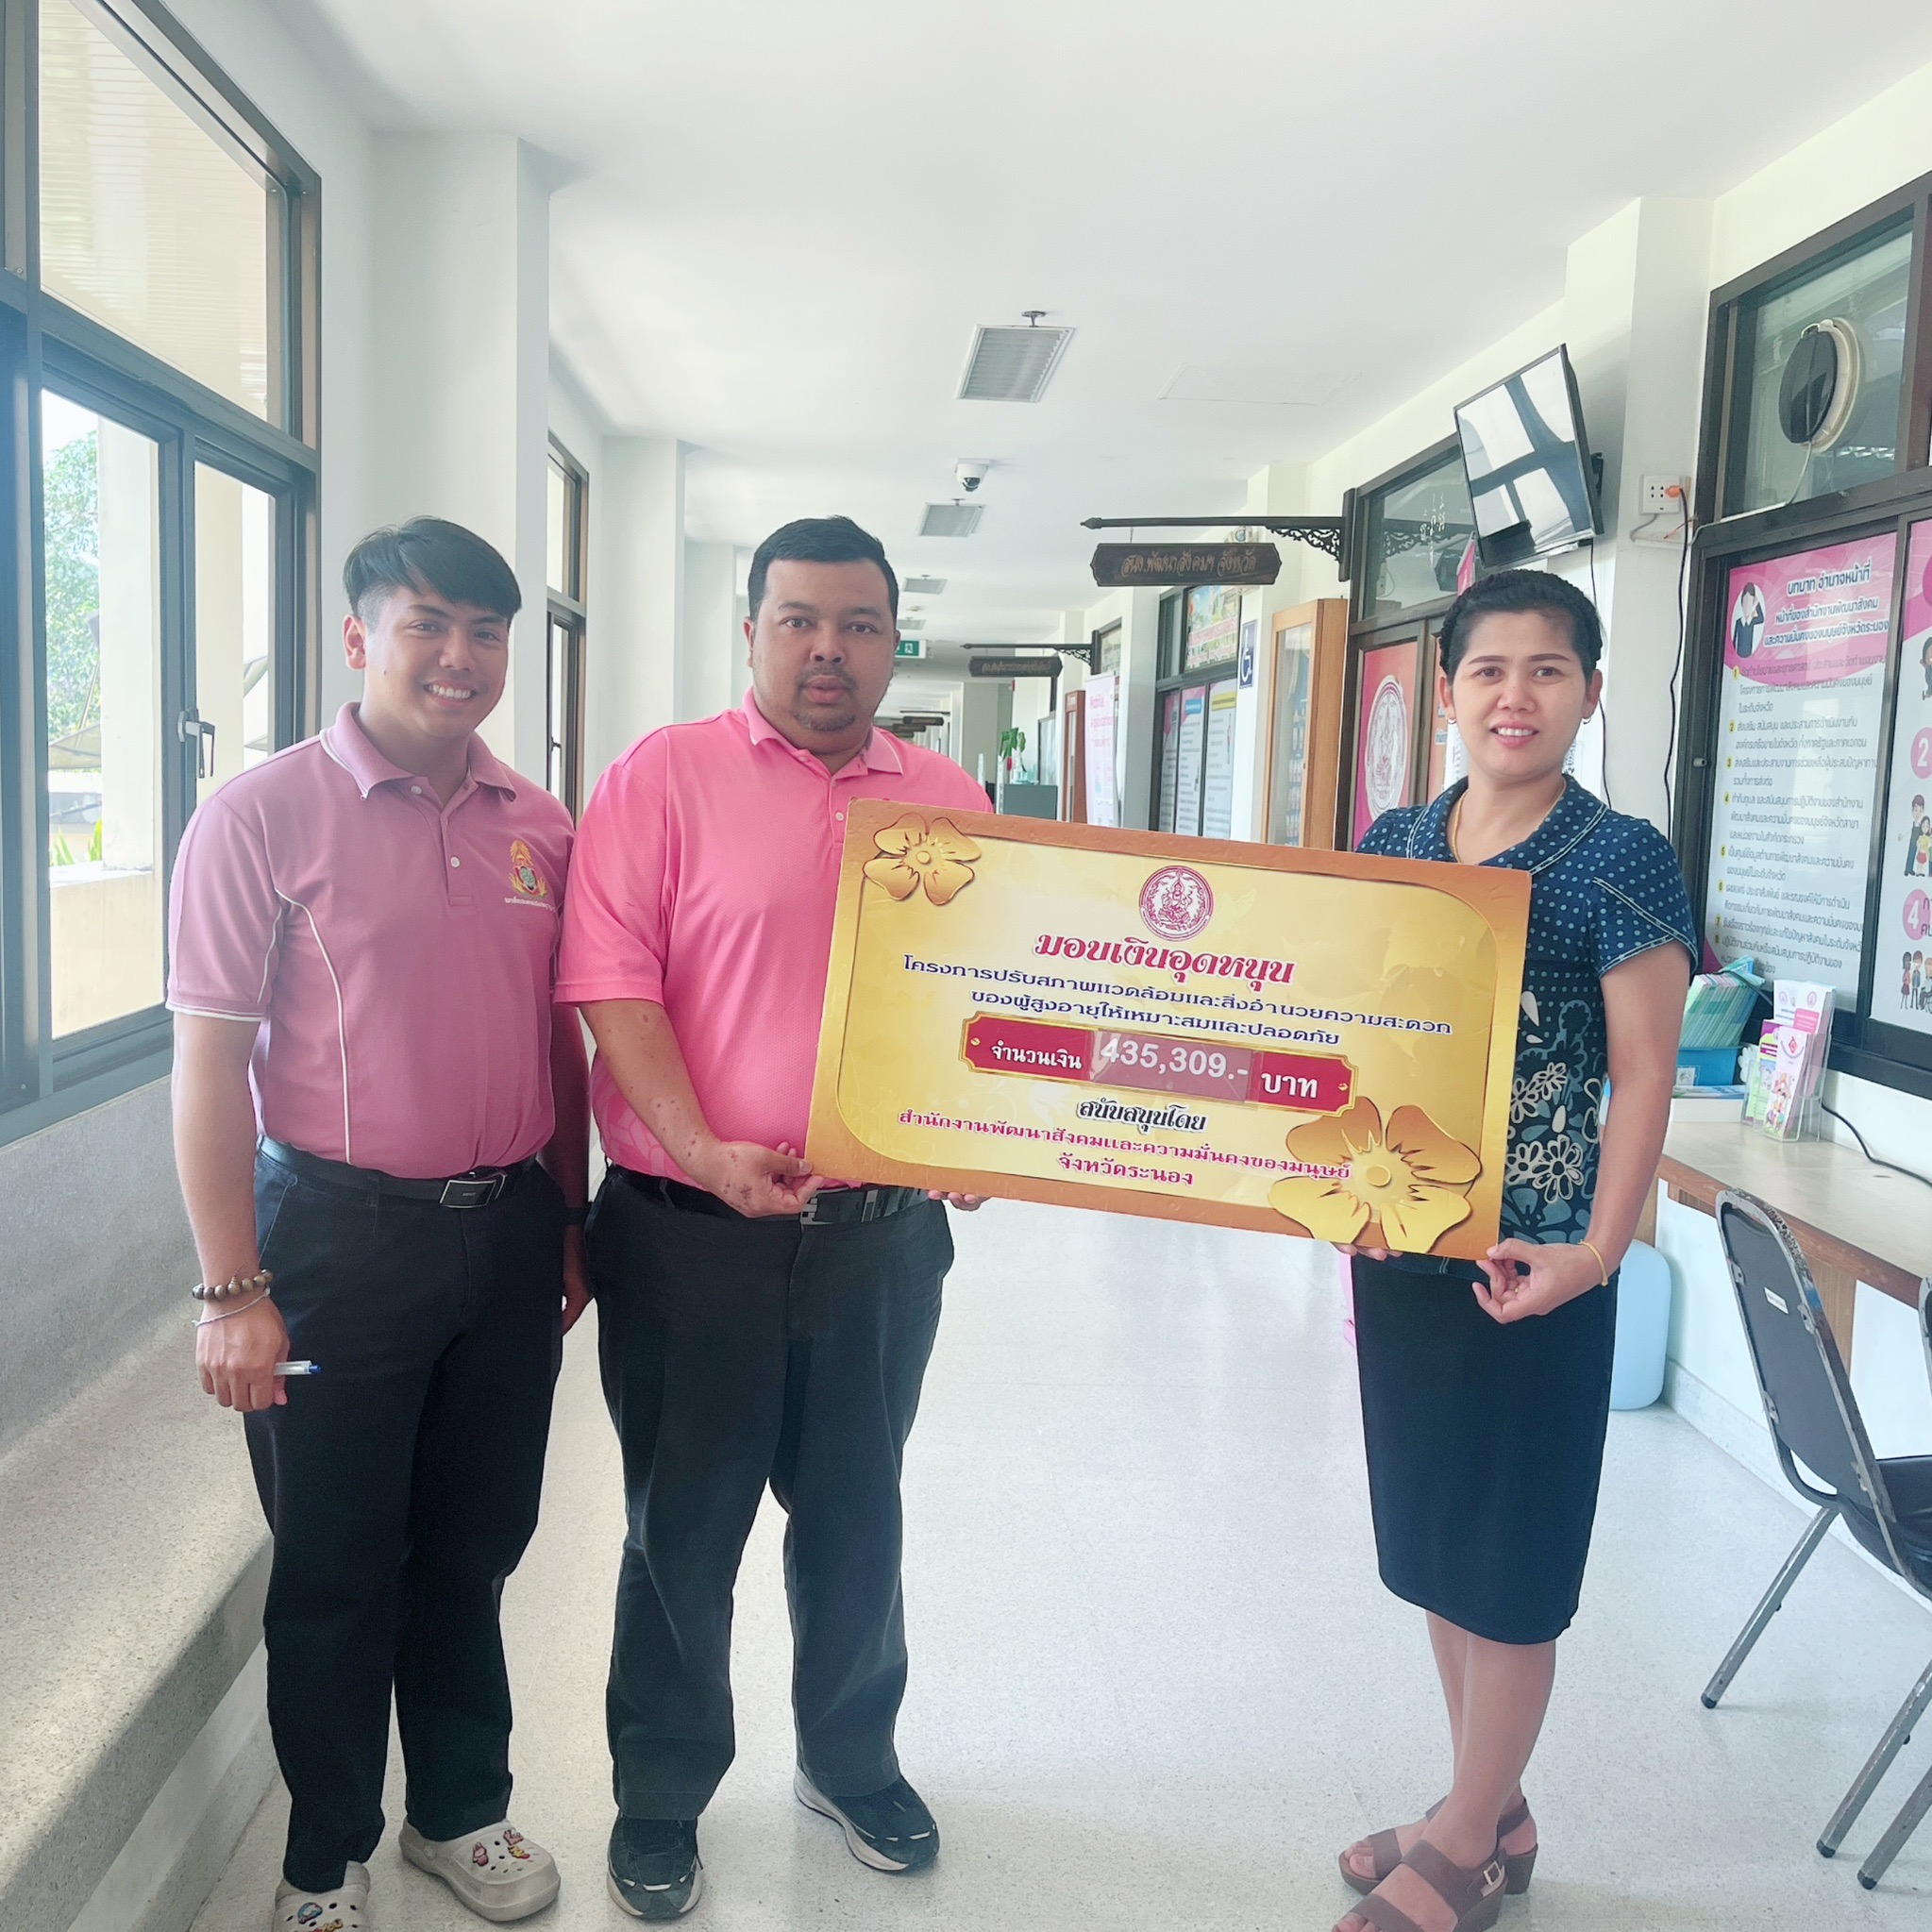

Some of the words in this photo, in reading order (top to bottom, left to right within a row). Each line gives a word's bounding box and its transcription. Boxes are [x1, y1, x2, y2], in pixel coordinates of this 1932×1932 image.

[1788, 579, 1816, 595] บทบาท
[1818, 558, 1871, 589] อำนาจหน้าที่
[1917, 737, 1928, 767] 2
[1907, 899, 1920, 930] 4
[1037, 934, 1294, 992] มอบเงินอุดหนุน
[903, 954, 1452, 1034] โครงการปรับสภาพแวดล้อมและสิ่งอำนวยความสะดวก
[971, 991, 1339, 1045] ของผู้สูงอายุให้เหมาะสมและปลอดภัย
[991, 1039, 1083, 1070] จำนวนเงิน
[1100, 1037, 1249, 1081] 435,309.-
[1260, 1070, 1318, 1099] บาท
[1078, 1099, 1206, 1134] สนับสนุนโดย
[899, 1109, 1350, 1180] สำนักงานพัฒนาสังคมและความมั่นคงของมนุษย์
[1058, 1151, 1194, 1185] จังหวัดระนอง
